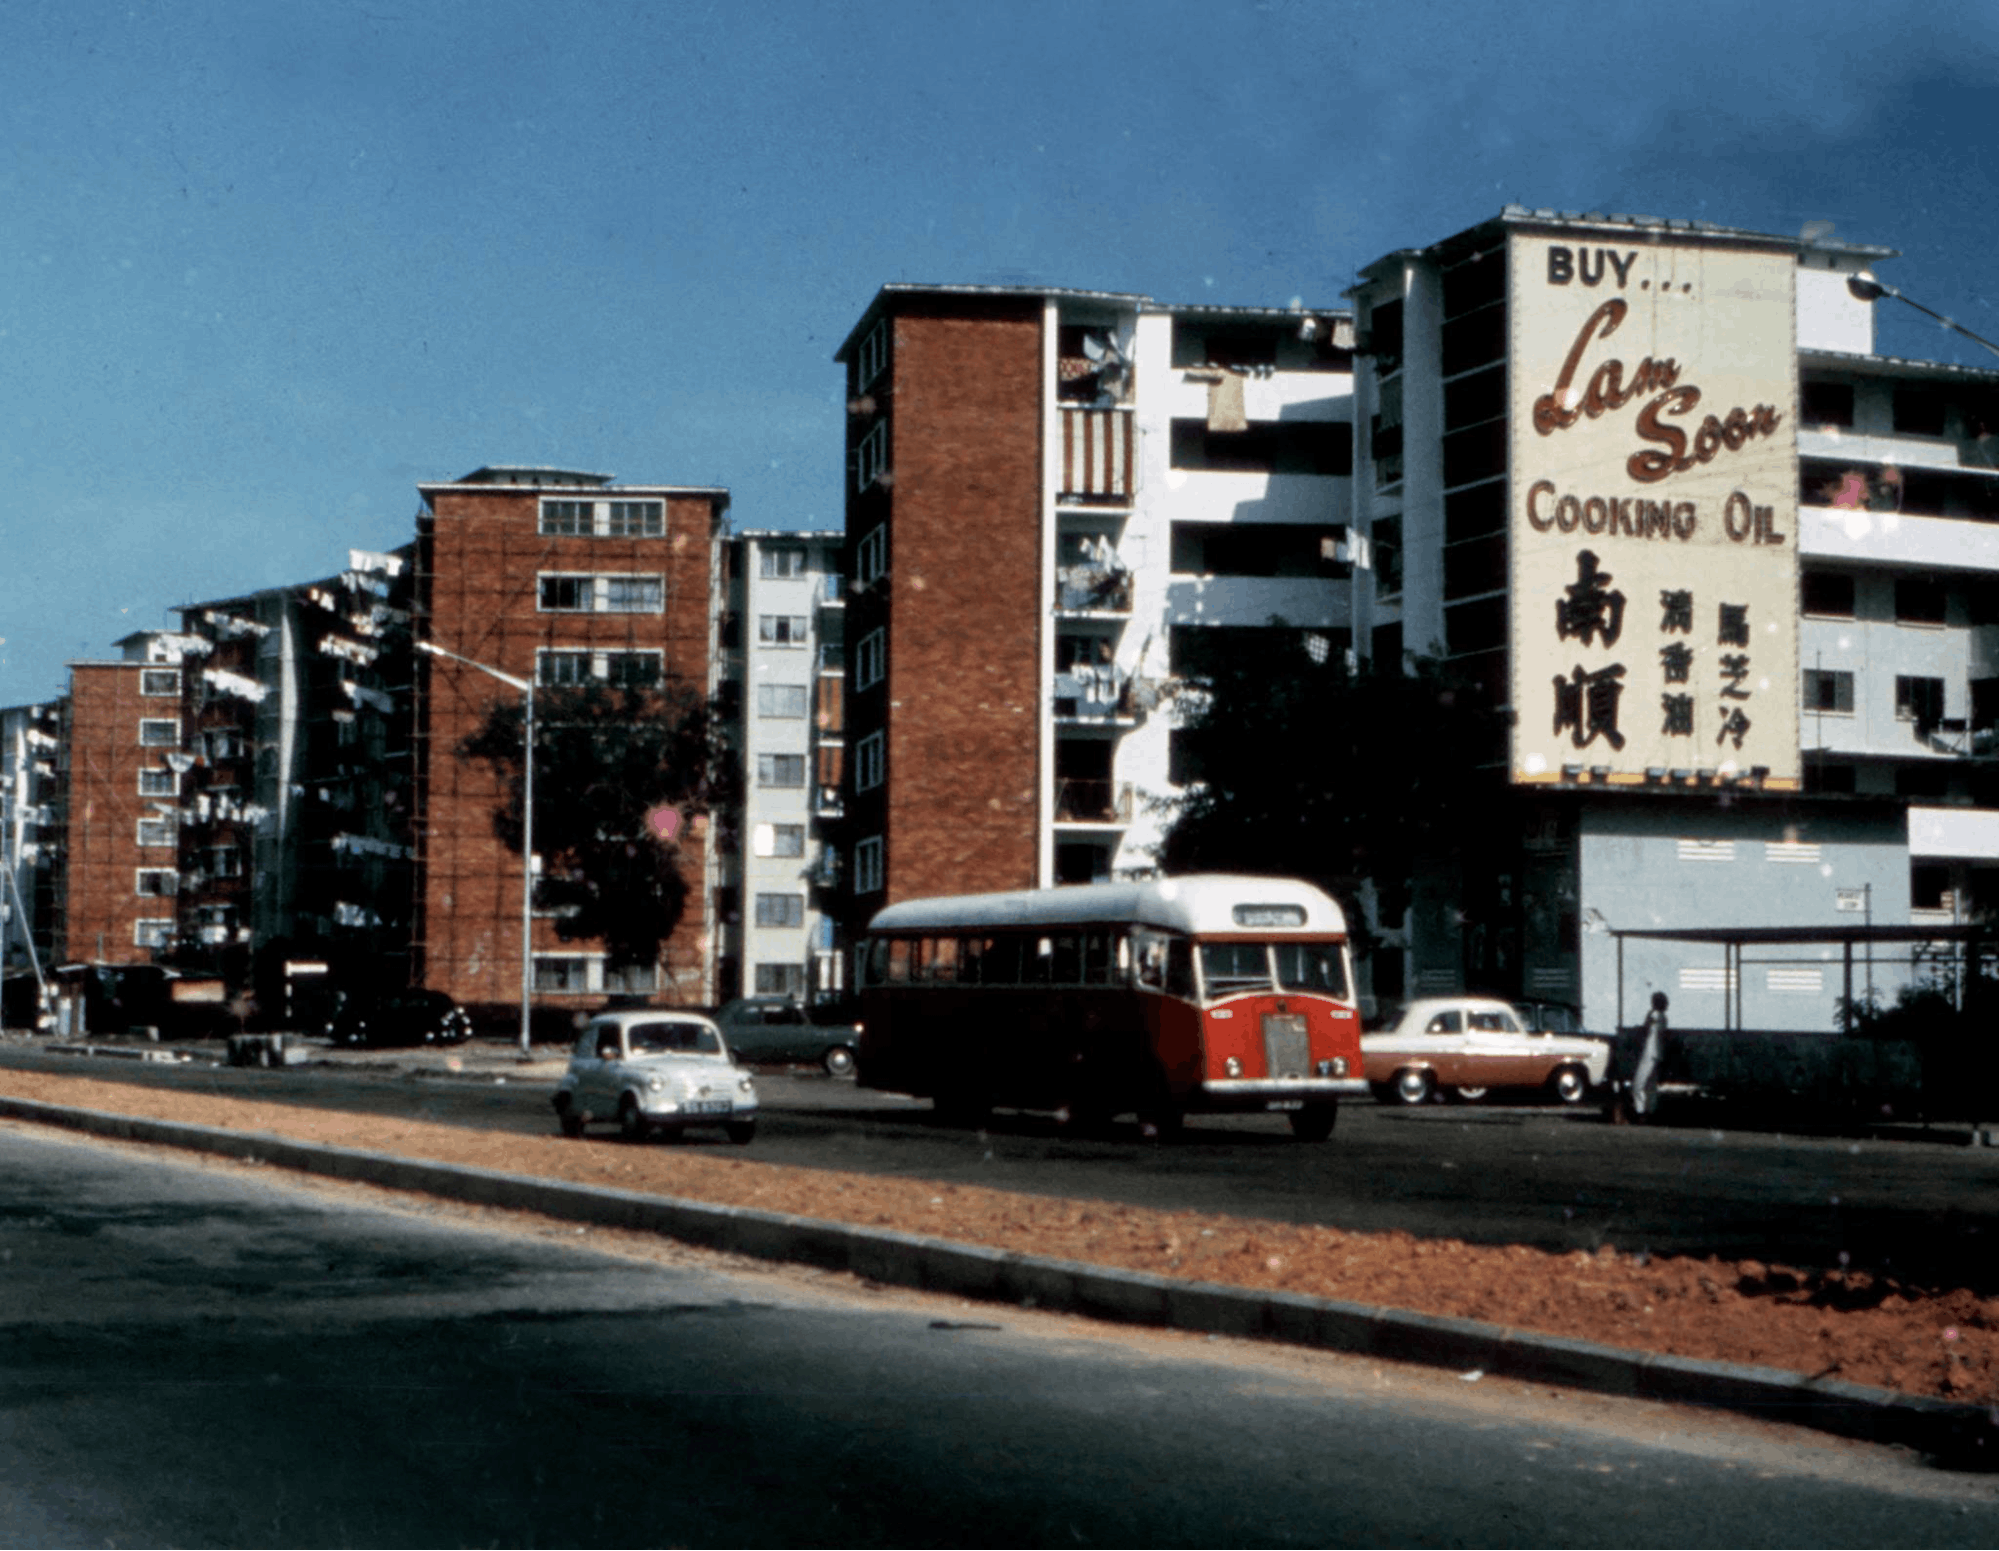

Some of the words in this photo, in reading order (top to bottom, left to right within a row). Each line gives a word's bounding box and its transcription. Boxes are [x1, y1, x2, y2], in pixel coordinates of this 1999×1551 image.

[1532, 297, 1682, 436] Lam
[1626, 384, 1782, 484] Soon
[1526, 479, 1697, 542] COOKING
[1724, 491, 1786, 545] OIL
